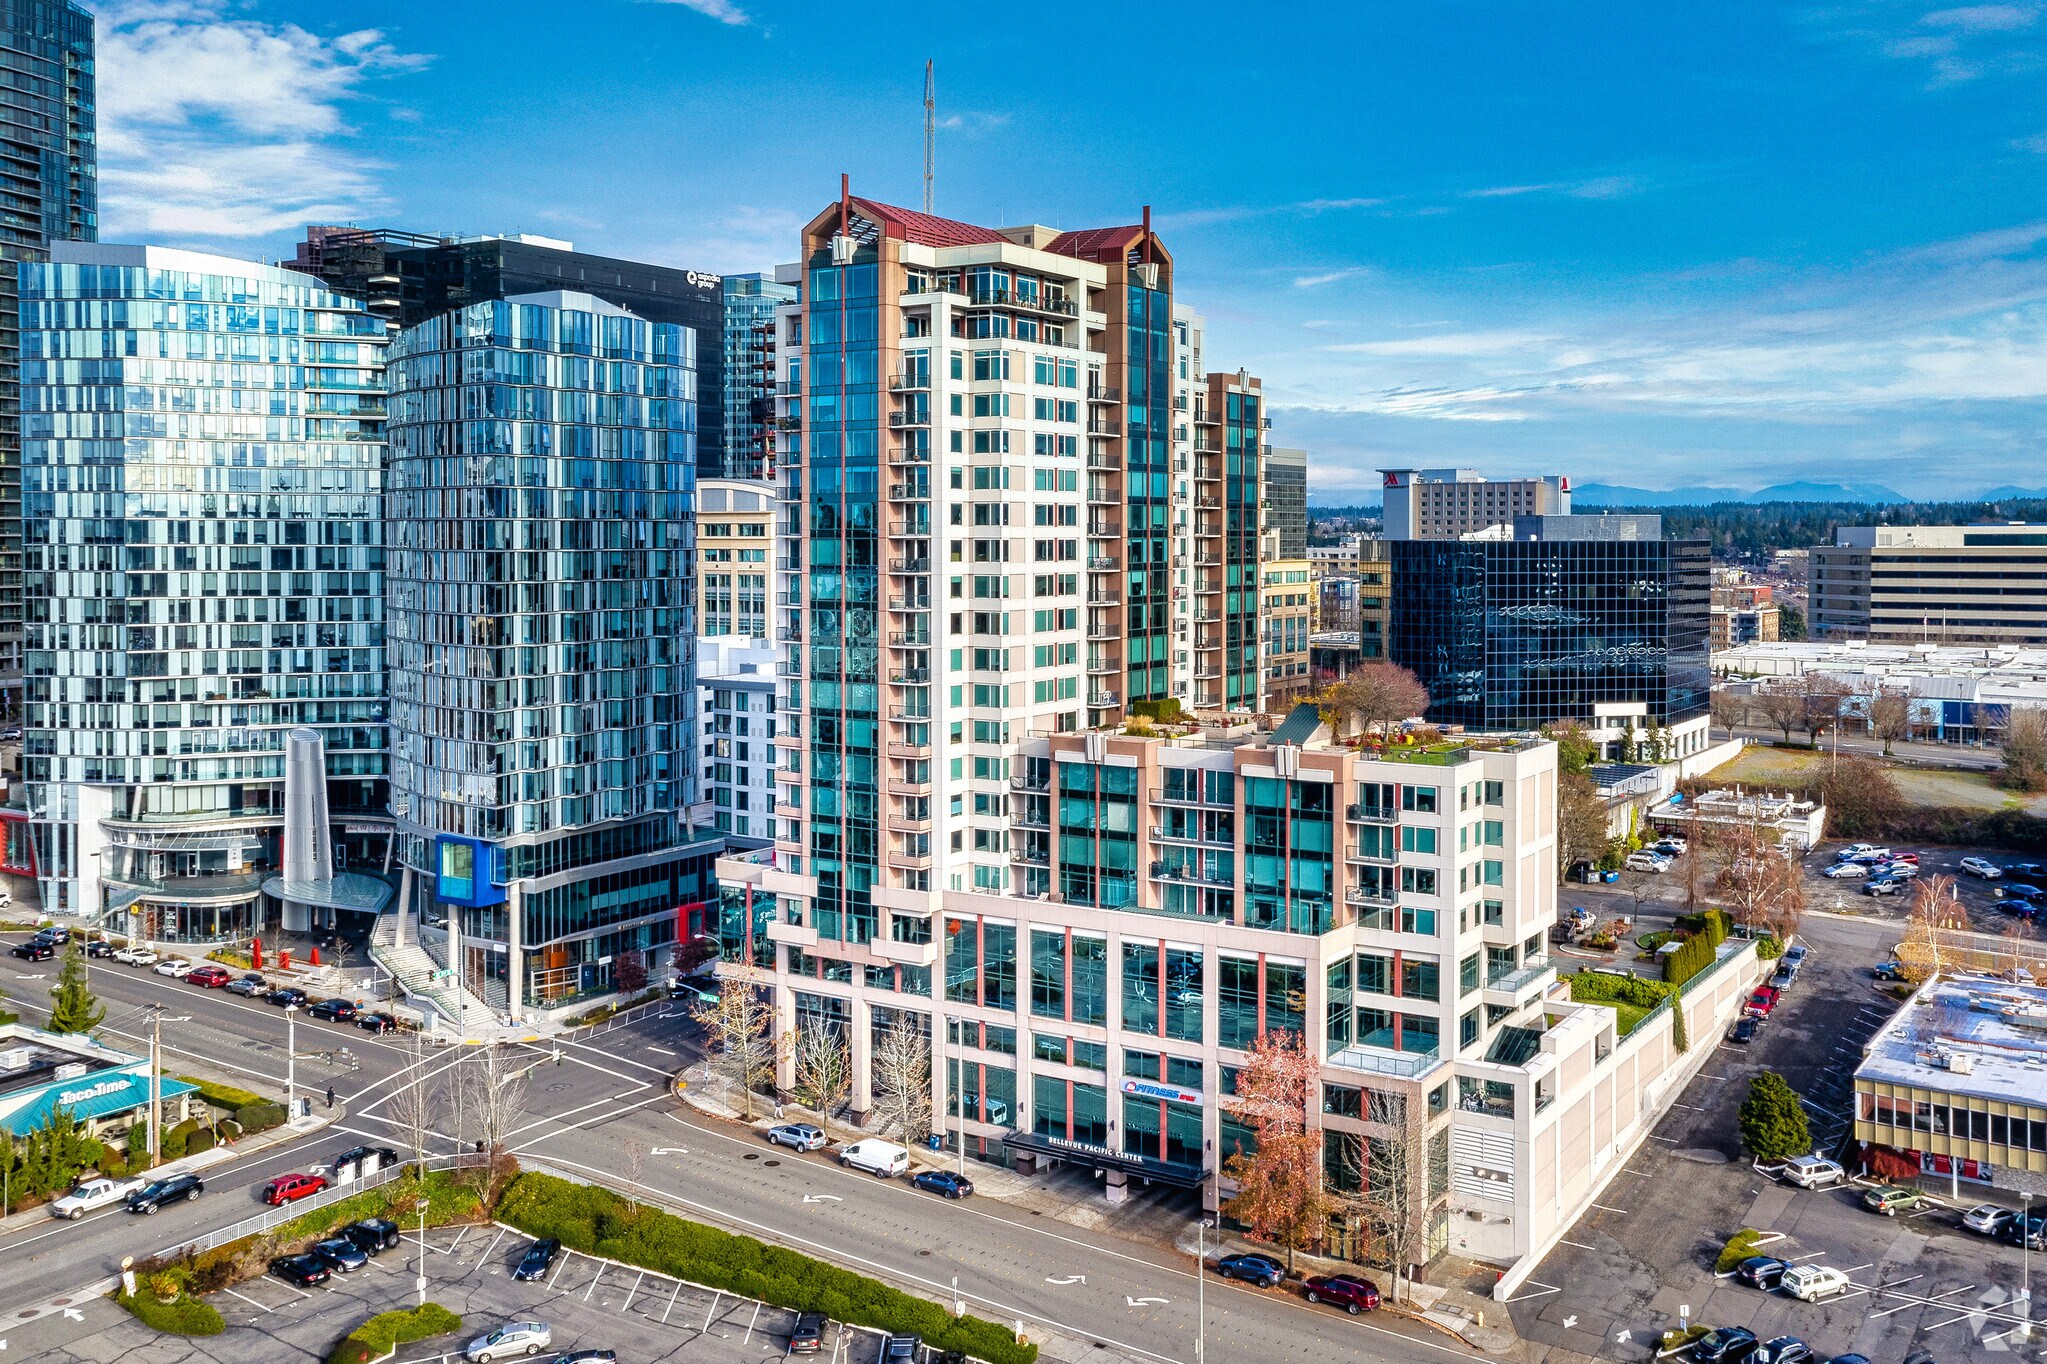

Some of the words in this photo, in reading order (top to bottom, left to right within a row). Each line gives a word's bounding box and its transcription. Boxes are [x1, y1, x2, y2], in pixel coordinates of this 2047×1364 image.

[697, 273, 720, 283] expedia
[697, 280, 715, 290] group
[1048, 1136, 1082, 1150] BELLEVUE
[1084, 1143, 1113, 1156] PACIFIC
[1115, 1151, 1143, 1163] CENTER
